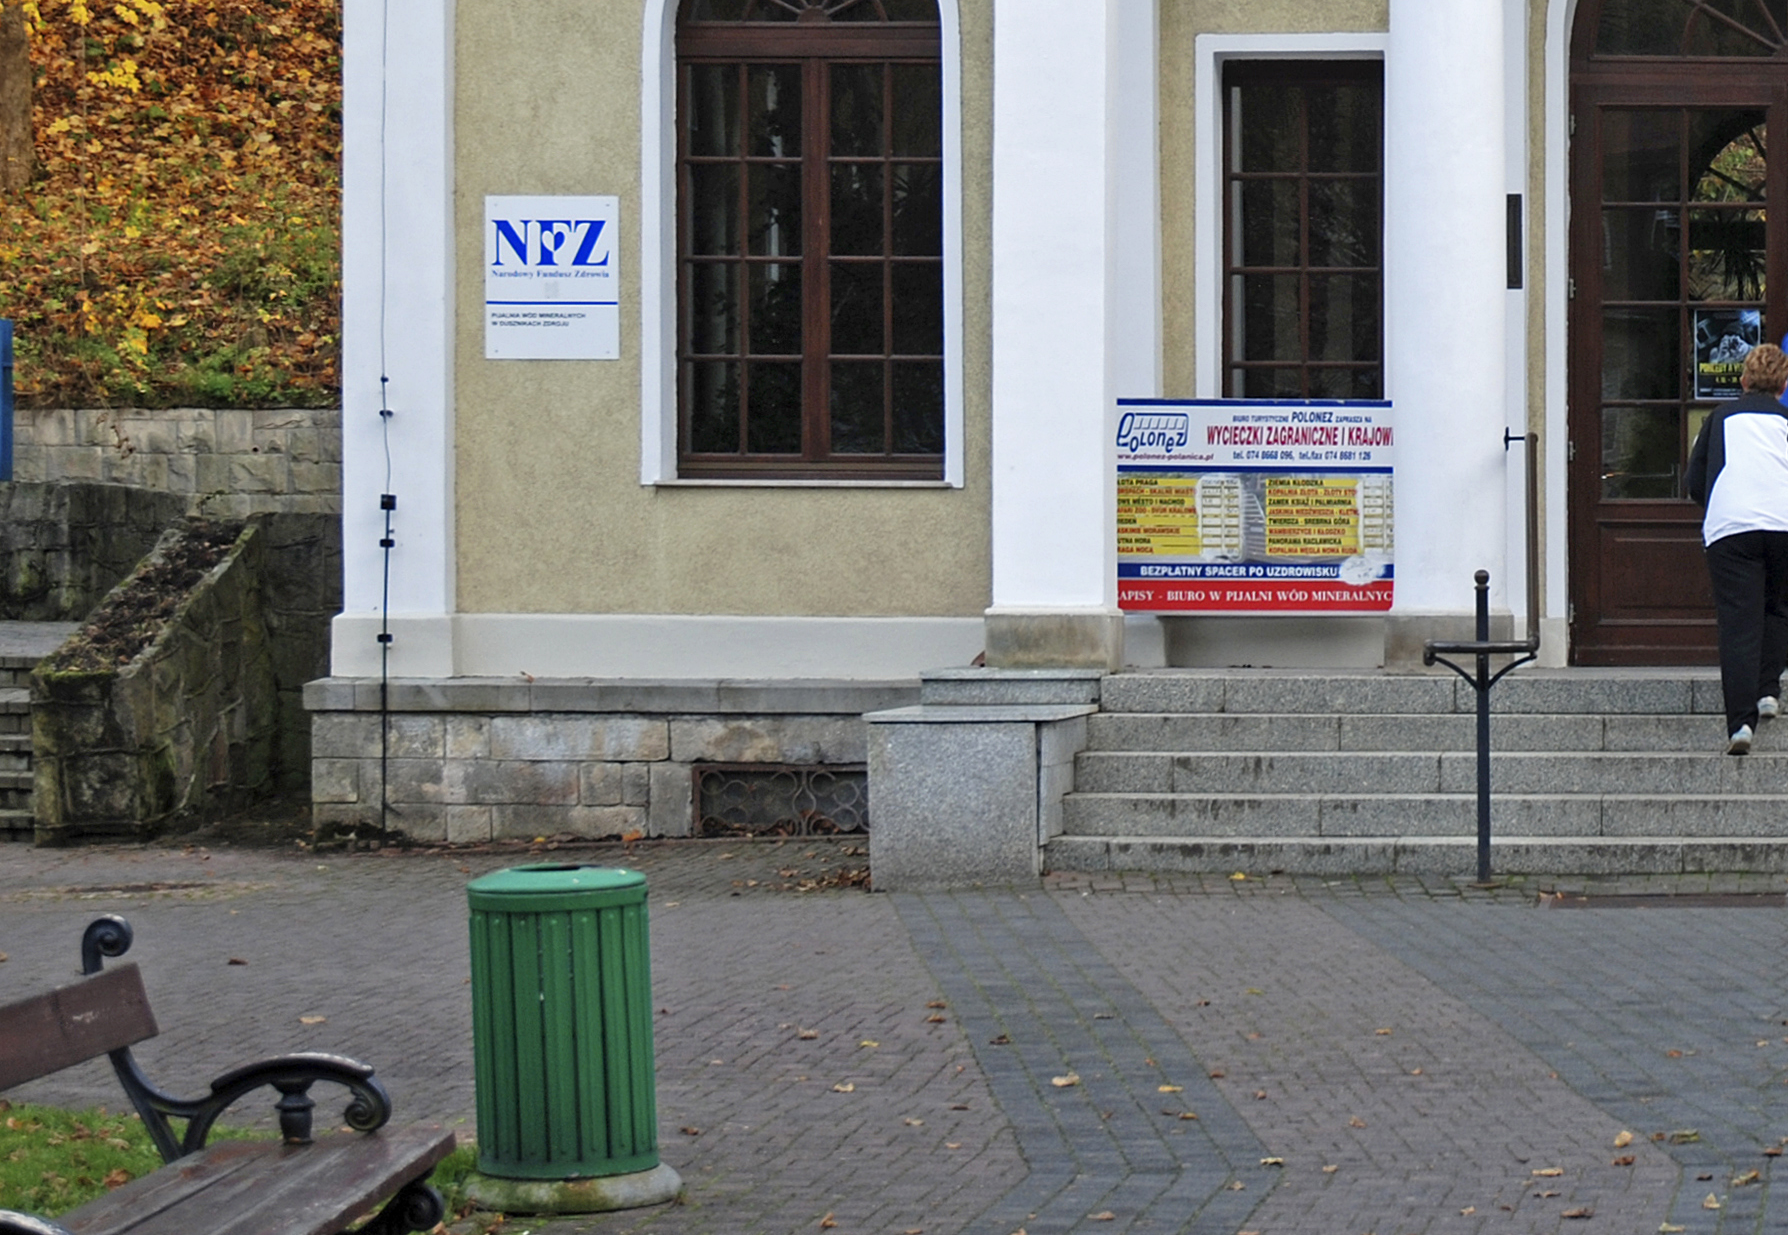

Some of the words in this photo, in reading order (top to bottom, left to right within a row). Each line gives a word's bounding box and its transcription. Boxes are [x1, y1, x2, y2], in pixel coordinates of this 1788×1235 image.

[491, 220, 609, 266] NFZ
[492, 270, 534, 279] Narodowy
[536, 270, 572, 278] Fundusz
[574, 270, 609, 278] Zdrowia
[1291, 412, 1334, 423] POLONEZ
[1207, 426, 1263, 445] WYCIECZKI
[1266, 426, 1339, 446] ZAGRANICZNE
[1341, 427, 1345, 446] I
[1233, 451, 1244, 459] tel.
[1246, 451, 1259, 459] 074
[1324, 451, 1338, 460] 074
[1315, 498, 1352, 506] PALMIARNIA
[1333, 517, 1350, 525] GÓRA
[1140, 566, 1202, 577] BEZPŁATNY
[1205, 566, 1246, 577] SPACER
[1249, 567, 1264, 577] PO
[1266, 567, 1337, 577] UZDROWISKU
[1167, 590, 1205, 601] BIURO
[1209, 590, 1223, 601] W
[1226, 591, 1272, 601] PIJALNI
[1277, 588, 1308, 601] WÓD
[1311, 591, 1392, 601] MINERALNYC
